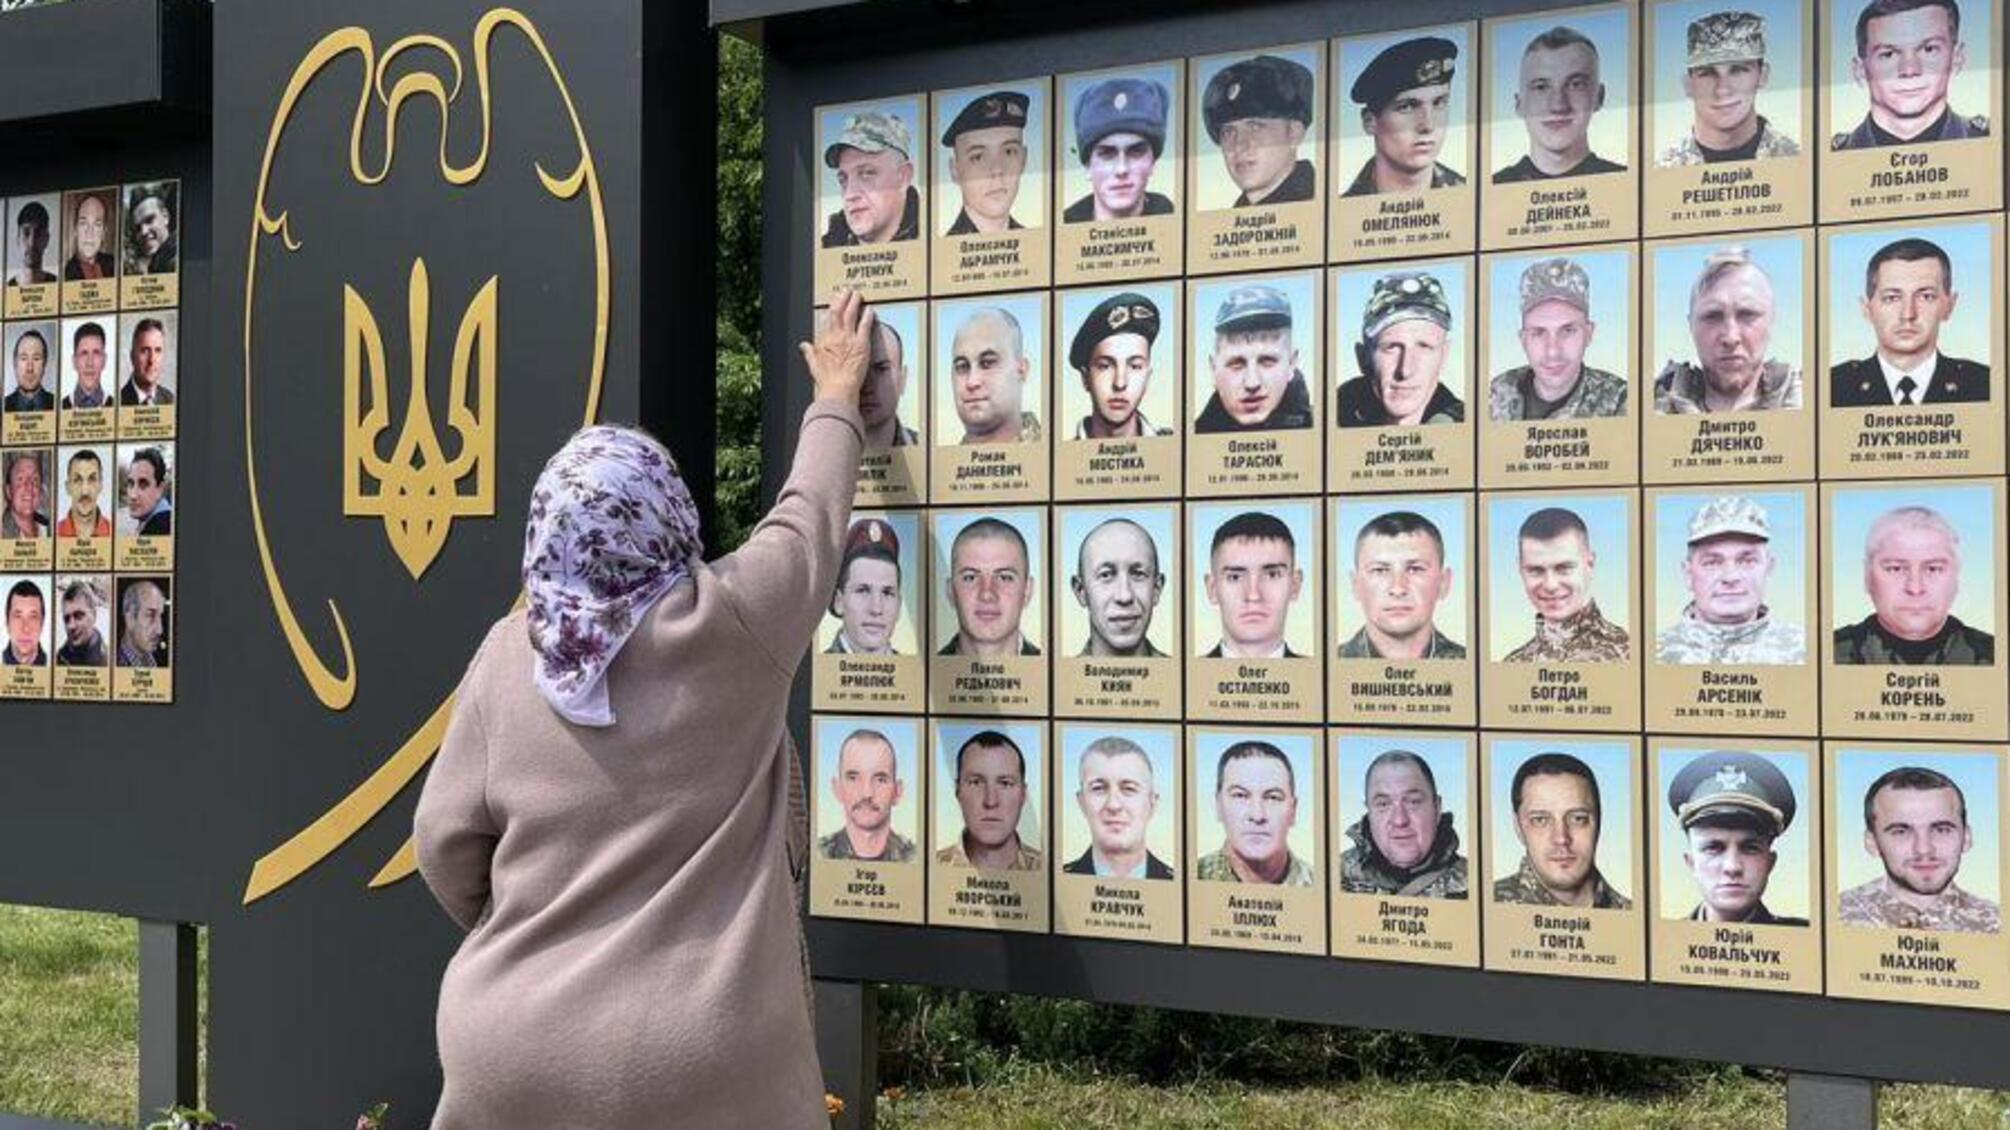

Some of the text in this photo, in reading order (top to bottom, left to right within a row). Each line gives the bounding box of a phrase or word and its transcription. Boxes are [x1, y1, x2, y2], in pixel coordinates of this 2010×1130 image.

[1890, 153, 1929, 167] Єгор
[1701, 168, 1753, 184] Андрій
[1870, 168, 1948, 188] ЛОБАНОВ
[1530, 189, 1587, 204] Олексій
[1683, 184, 1772, 203] РЕШЕТІЛОВ
[1379, 199, 1424, 214] Андрій
[1235, 213, 1276, 227] Андрій
[1362, 213, 1440, 232] ОМЕЛЯНЮК
[1526, 206, 1591, 224] ДЕЙНЕКА
[1090, 226, 1146, 240] Станіслав
[1081, 240, 1155, 257] МАКСИМЧУК
[1699, 420, 1756, 436] Дмитро
[1864, 414, 1954, 428] Олександр
[1378, 433, 1422, 448] Сергій
[1527, 427, 1587, 441] Ярослав
[1858, 429, 1962, 448] ЛУК'ЯНОВИЧ
[1229, 440, 1276, 452] Олексій
[1525, 441, 1590, 458] ВОРОБЕЙ
[1691, 436, 1763, 454] ДЯЧЕНКО
[972, 451, 1006, 462] Роман
[1090, 457, 1144, 470] МОСТИКА
[1223, 454, 1283, 468] ТАРАСЮК
[1365, 448, 1434, 466] ДЕМ'ЯНИК
[957, 464, 1021, 479] ДАНИЛЕВИЧ
[1084, 665, 1149, 678] Володимир
[1238, 666, 1268, 678] Олег
[1385, 667, 1415, 681] Олег
[1539, 669, 1580, 683] Петро
[1702, 671, 1757, 686] Василь
[956, 677, 1021, 690] РЕДЬКОВИЧ
[1101, 680, 1132, 692] КИЯН
[1218, 682, 1290, 694] ОСТАПЕНКО
[1886, 673, 1940, 689] Сергій
[1351, 681, 1453, 698] ВИШНЕВСЬКИЙ
[1531, 686, 1587, 702] БОГДАН
[1697, 689, 1762, 704] АРСЕНІК
[1881, 692, 1946, 707] КОРЕНЬ
[1095, 885, 1140, 900] Микола
[1091, 901, 1145, 917] КРАВЧУК
[1228, 896, 1283, 911] Анатолій
[1378, 902, 1429, 918] Дмитро
[1382, 919, 1427, 935] ЯГОДА
[1534, 914, 1591, 931] Валерій
[1539, 934, 1586, 950] ГОНТА
[1715, 929, 1753, 944] Юрій
[1897, 935, 1940, 952] Юрій
[1688, 945, 1781, 965] КОВАЛЬЧУК
[1881, 953, 1957, 973] МАХНЮК
